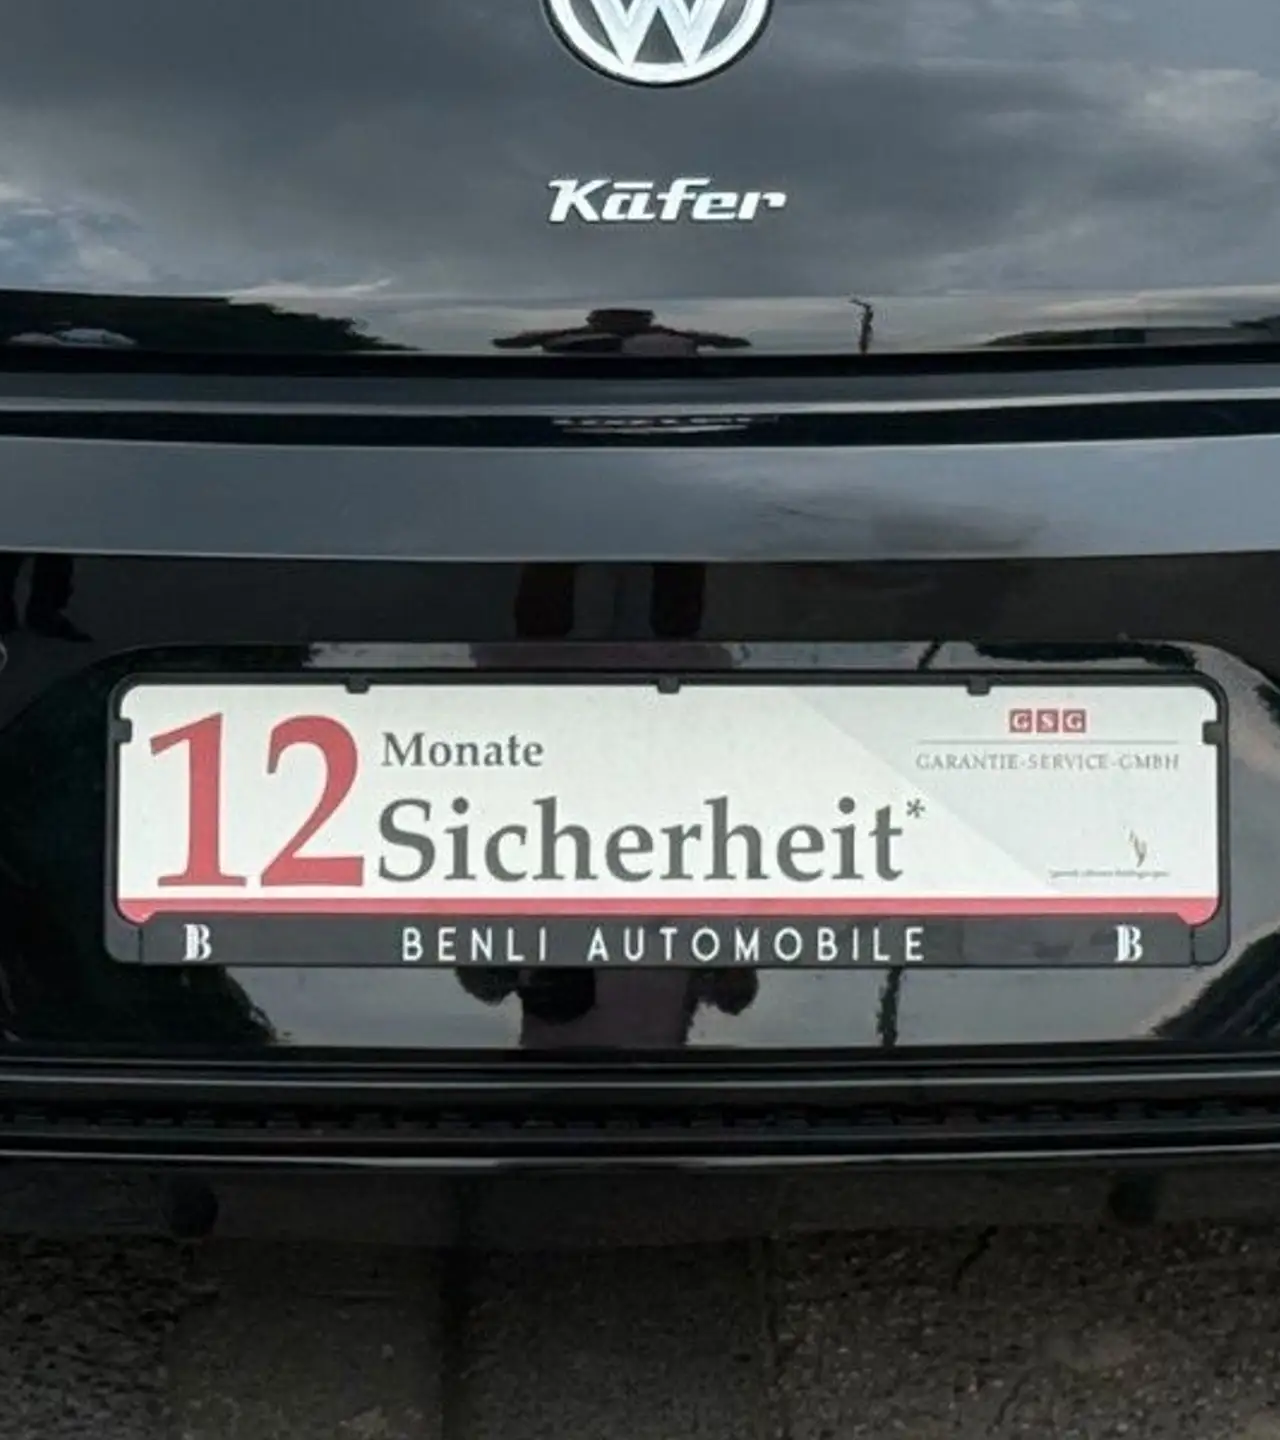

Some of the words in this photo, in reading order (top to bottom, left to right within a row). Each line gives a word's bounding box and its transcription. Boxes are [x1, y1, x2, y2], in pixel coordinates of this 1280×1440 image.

[548, 177, 788, 223] Käfer
[1009, 708, 1087, 734] GSG
[382, 732, 545, 768] Monate
[149, 711, 365, 887] 12
[401, 926, 548, 962] BENLI
[586, 925, 925, 962] AUTOMOBILE
